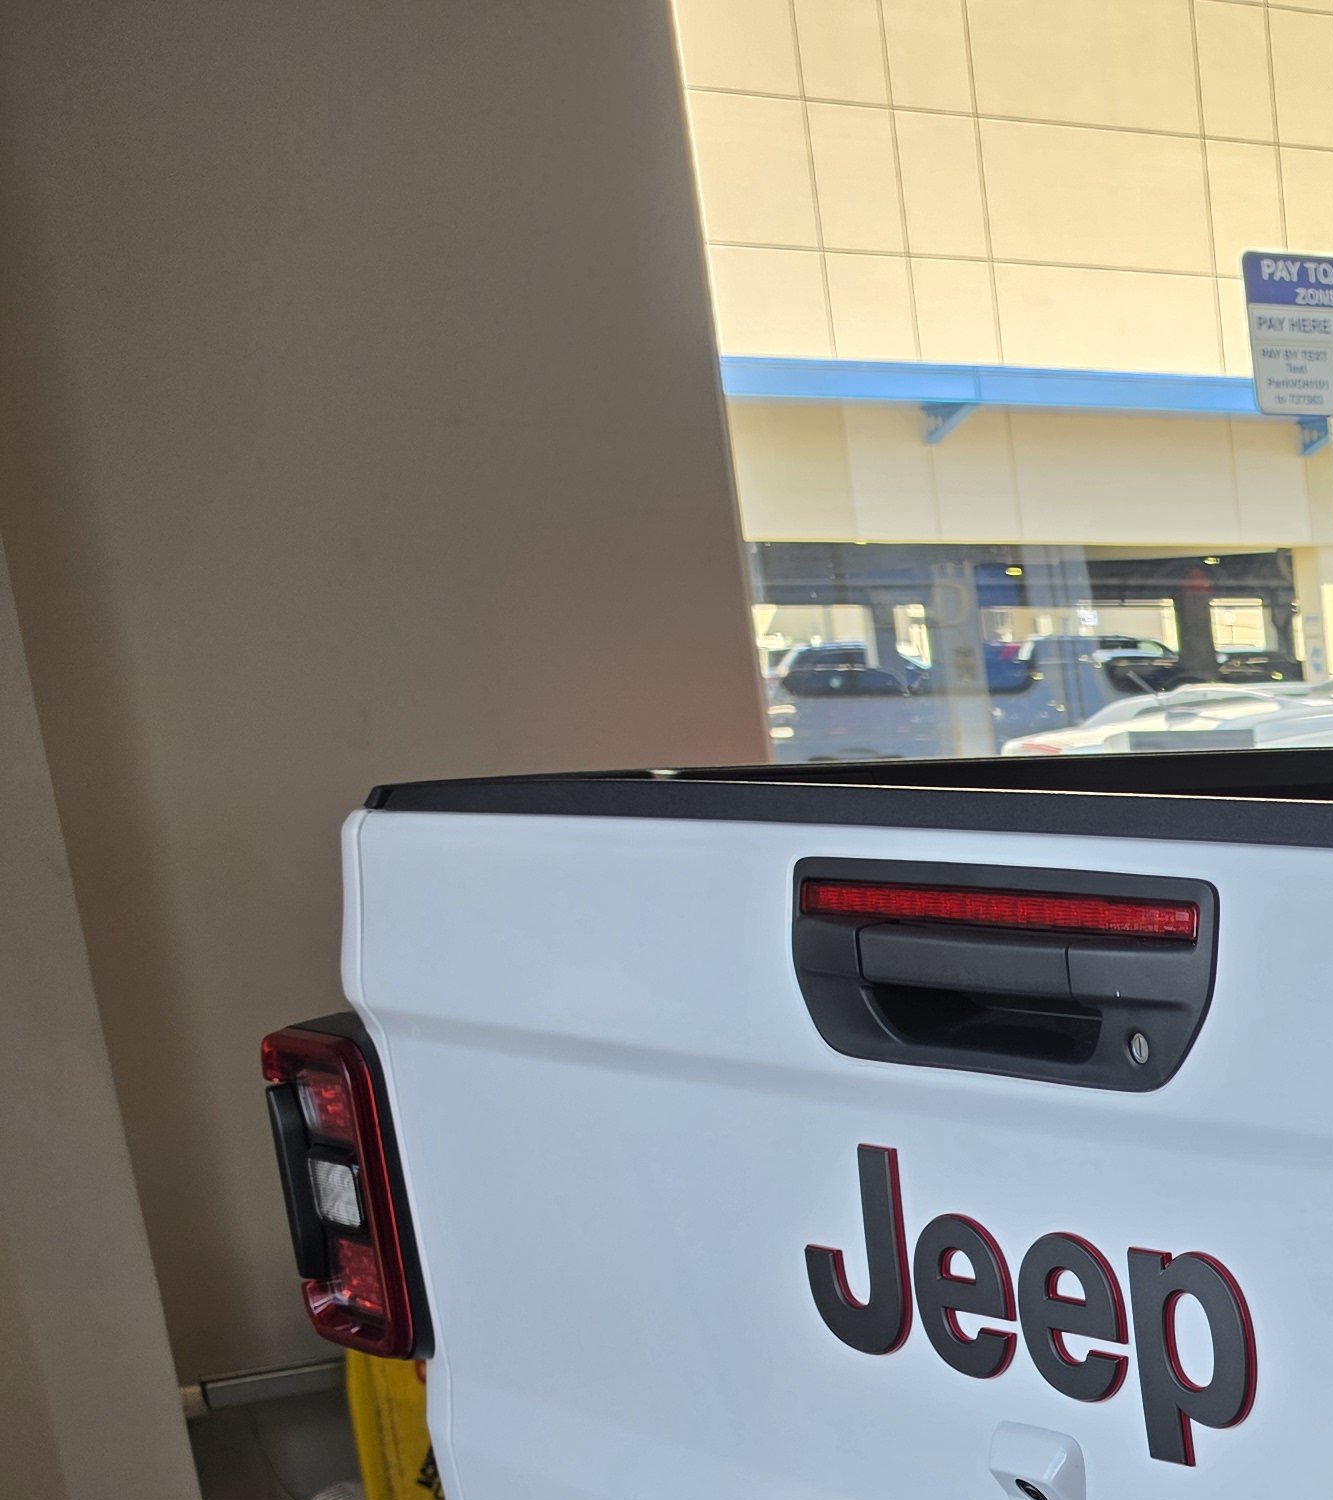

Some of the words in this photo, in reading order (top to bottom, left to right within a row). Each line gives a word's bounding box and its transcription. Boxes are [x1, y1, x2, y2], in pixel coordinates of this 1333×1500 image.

[1260, 258, 1300, 282] PAY
[1256, 315, 1286, 331] PAY
[1289, 317, 1330, 334] HERE
[804, 1142, 1258, 1467] Jeep
